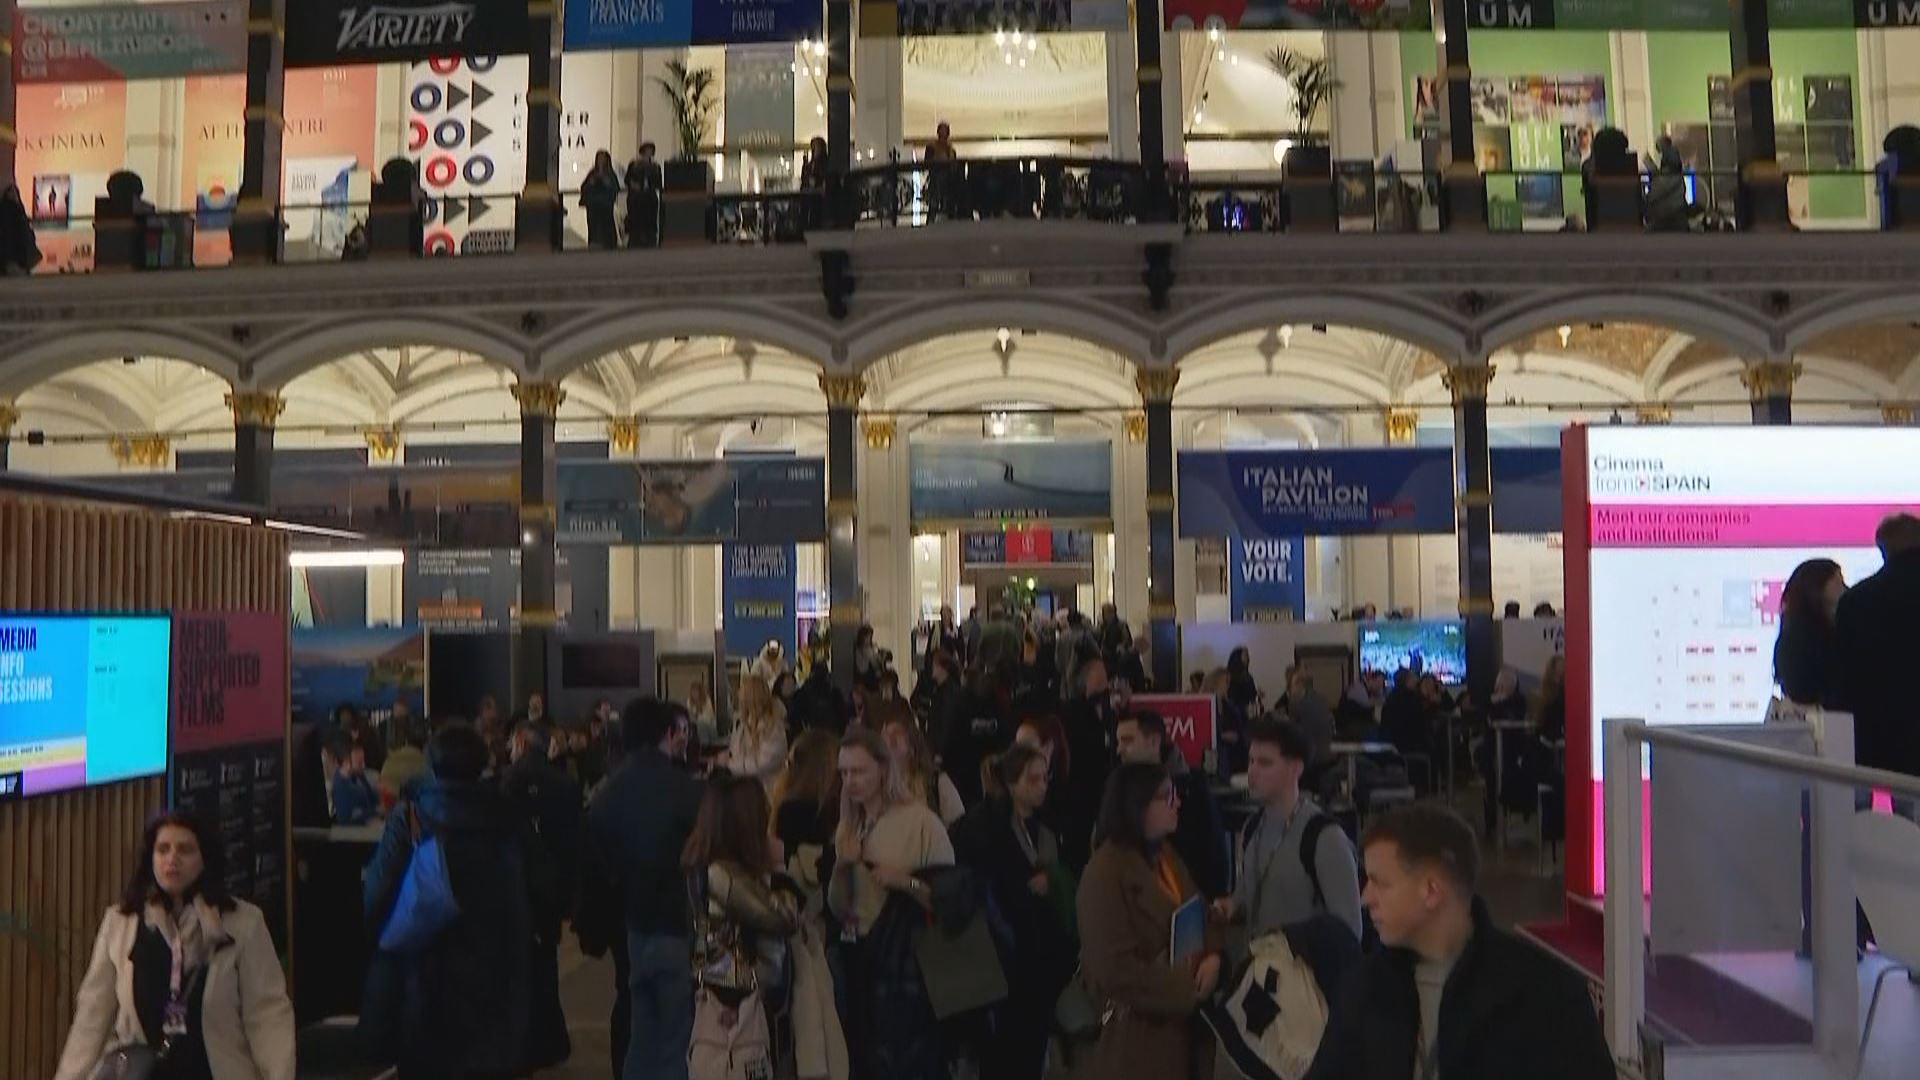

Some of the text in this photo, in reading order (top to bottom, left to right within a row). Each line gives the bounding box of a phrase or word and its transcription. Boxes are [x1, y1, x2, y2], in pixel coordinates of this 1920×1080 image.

[337, 3, 475, 51] VARIETY
[38, 132, 106, 150] CINEMA
[1593, 454, 1664, 472] Cinema
[1243, 465, 1334, 488] ITALIAN
[1652, 475, 1711, 492] SPAIN
[1261, 484, 1369, 507] PAVILION
[1597, 509, 1751, 526] Meet our companies
[1598, 528, 1626, 542] and
[1242, 540, 1293, 560] YOUR
[1241, 561, 1294, 584] VOTE.
[0, 626, 37, 652] MEDIA
[179, 618, 228, 655] MEDIA
[0, 653, 25, 679] NFO
[179, 651, 262, 691] SUPPORTED
[179, 687, 226, 728] FILMS
